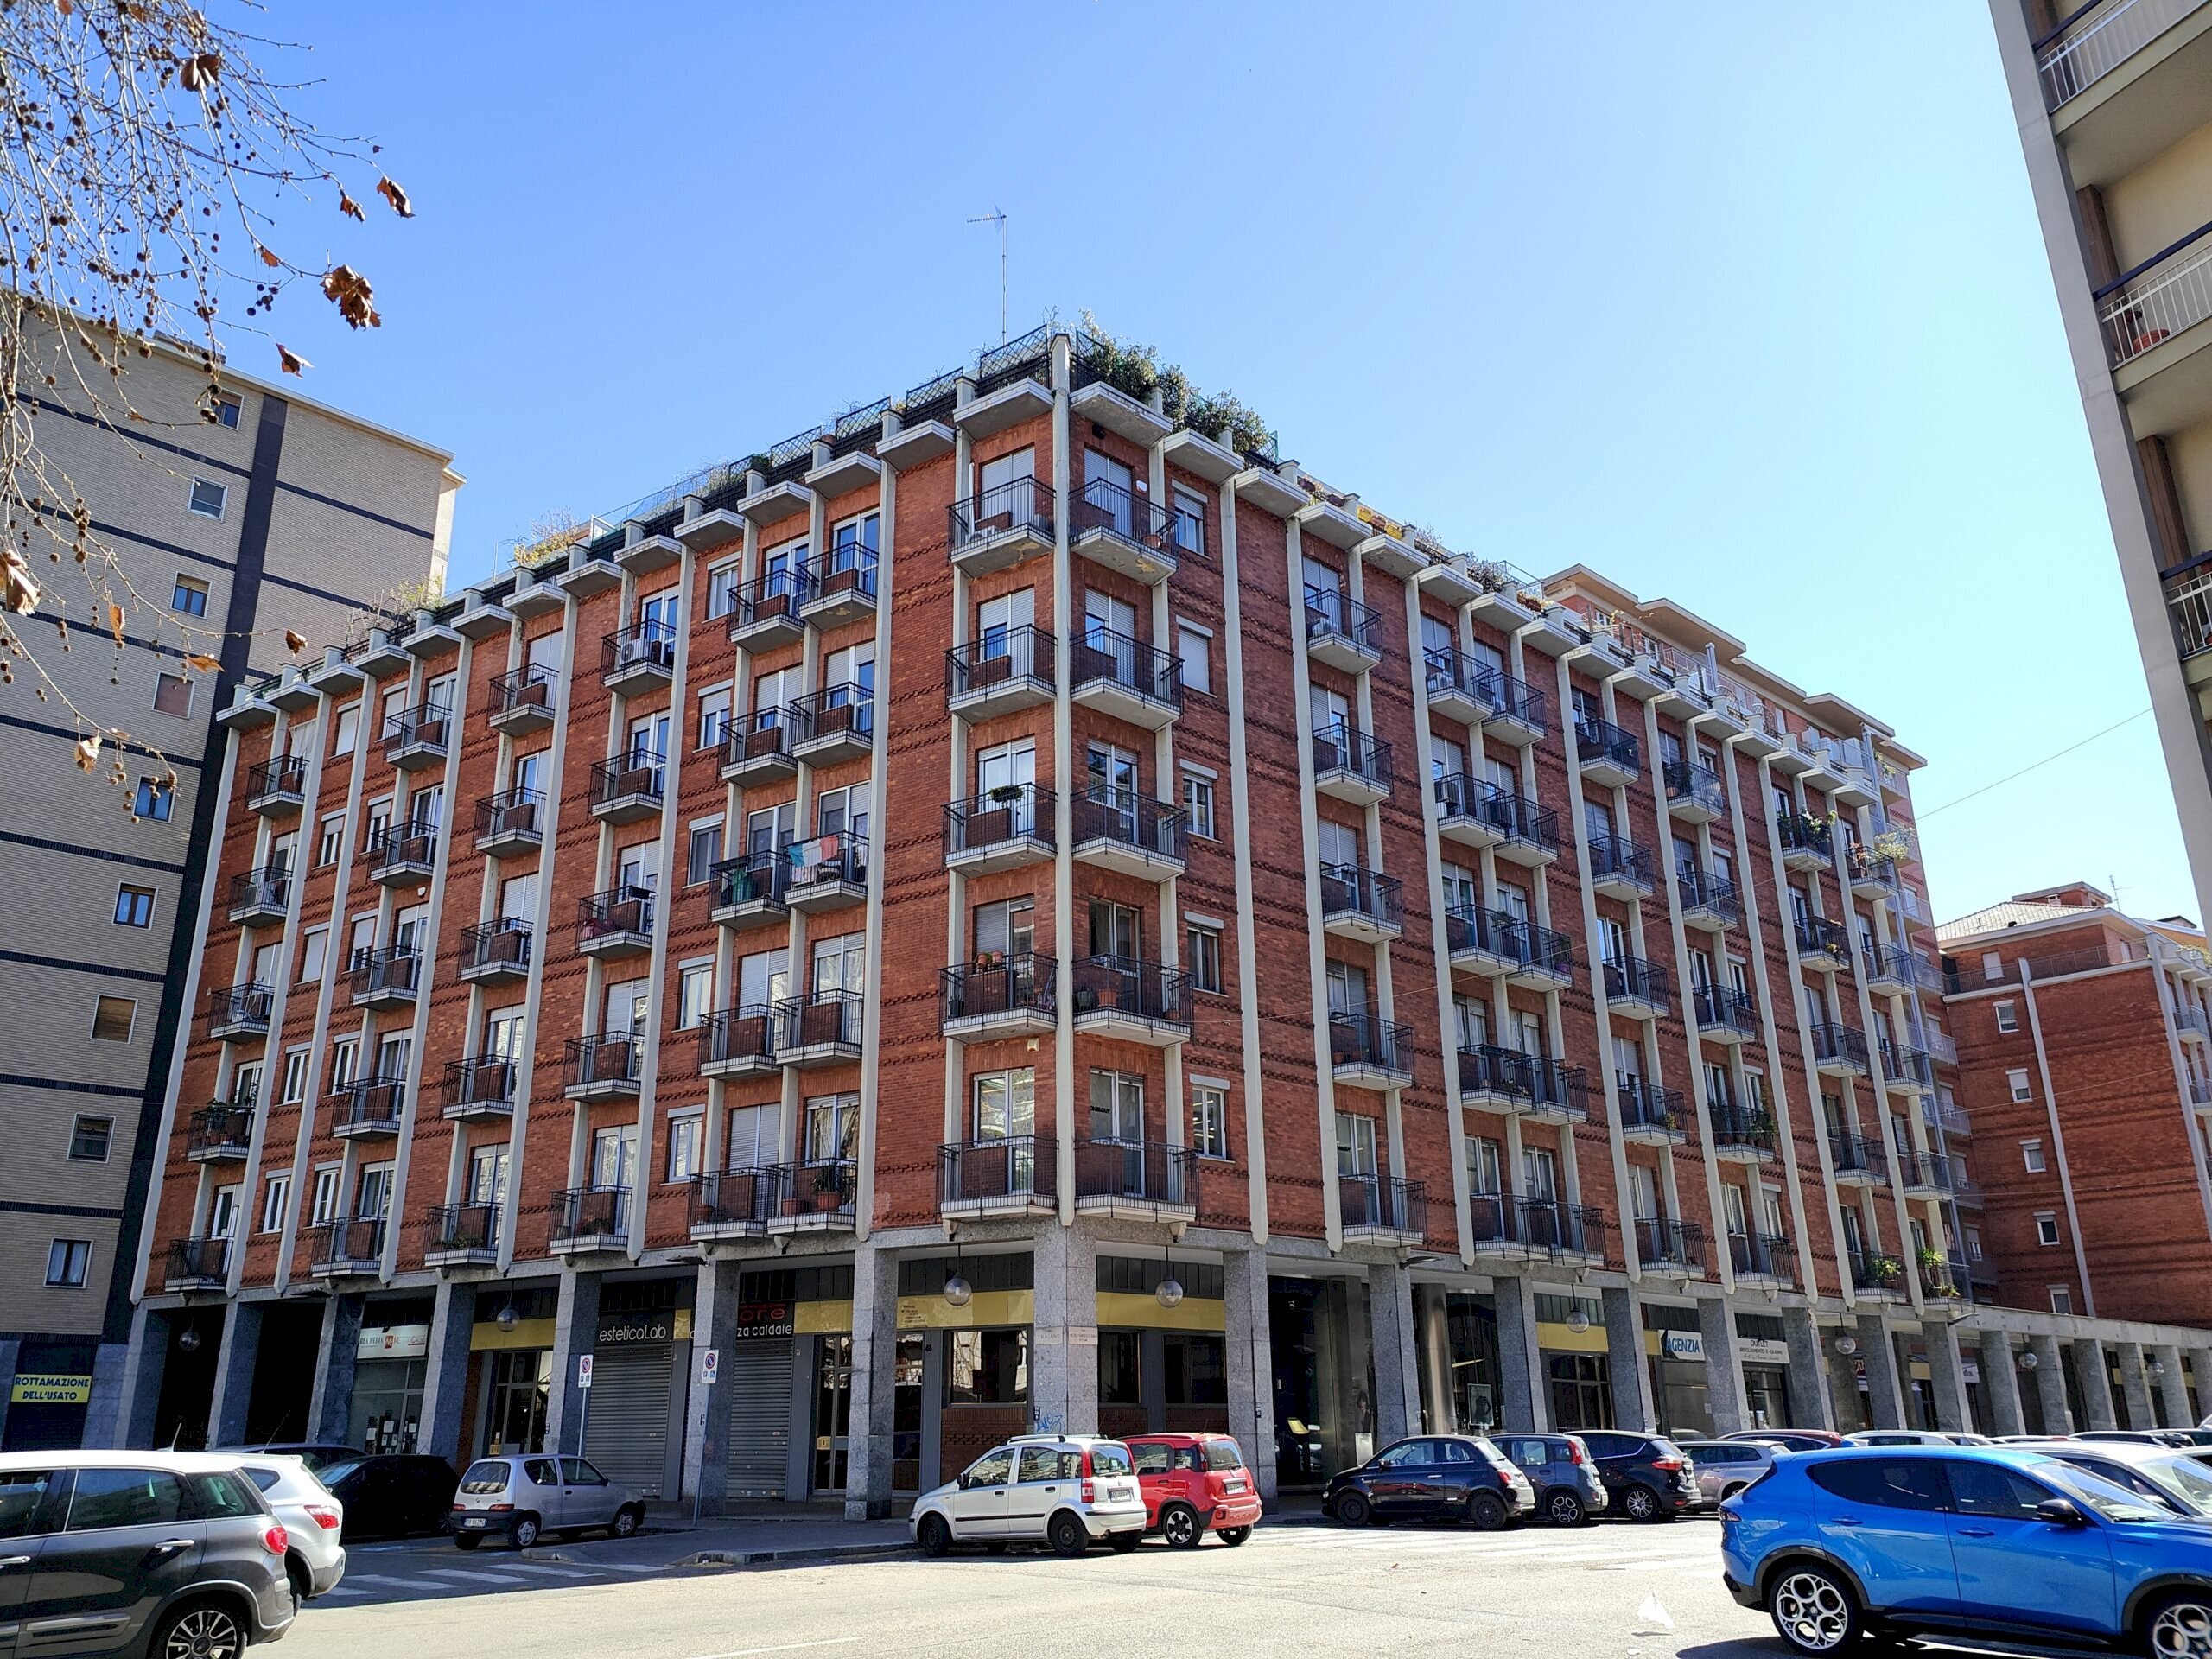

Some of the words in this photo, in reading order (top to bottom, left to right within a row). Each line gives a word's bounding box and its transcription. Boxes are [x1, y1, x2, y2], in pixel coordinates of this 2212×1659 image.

[599, 1323, 667, 1342] esteticaLab
[752, 1324, 792, 1336] caldaie
[1666, 1338, 1700, 1353] AGENZIA
[15, 1377, 90, 1387] ROTTAMAZIONE
[22, 1391, 78, 1400] DELL'USATO
